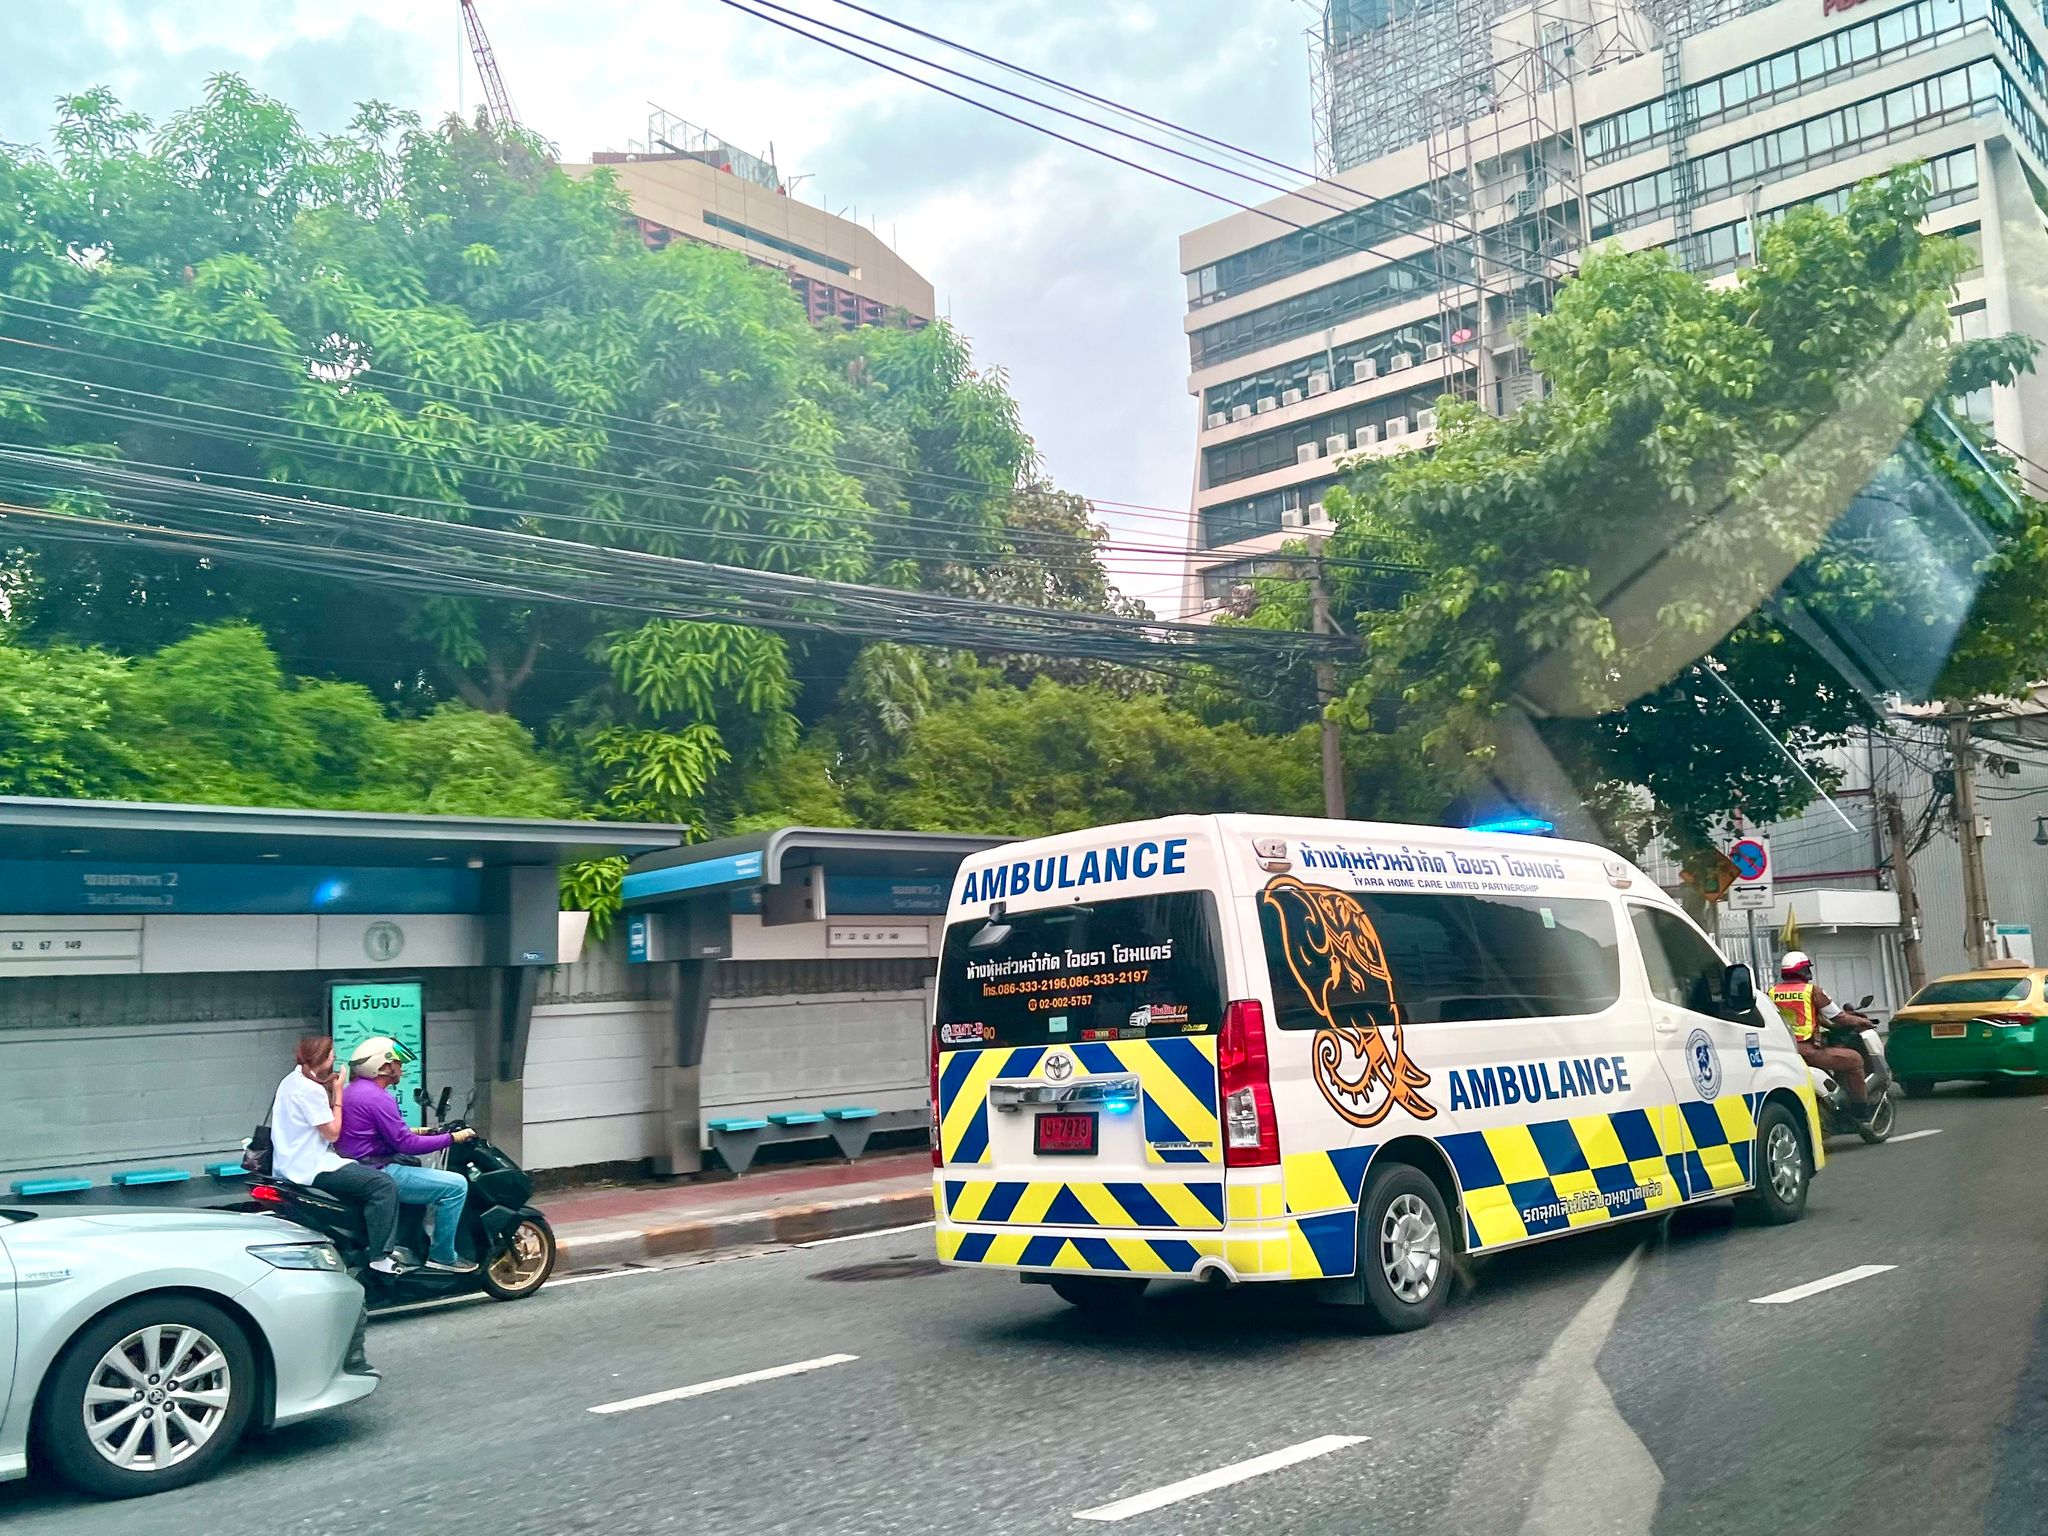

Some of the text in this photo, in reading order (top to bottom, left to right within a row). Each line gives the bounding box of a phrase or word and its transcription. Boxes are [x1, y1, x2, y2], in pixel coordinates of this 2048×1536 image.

[960, 838, 1187, 905] AMBULANCE
[1299, 842, 1448, 877] ห้างหุ้นส่วนจำกัด
[1448, 851, 1500, 876] ไอยรา
[1388, 878, 1415, 888] HOME
[1418, 879, 1443, 889] CARE
[1445, 880, 1479, 891] LIMITED
[1482, 882, 1539, 893] PARTNERSHIP
[966, 938, 1174, 983] ห้างหุ้นส่วนจำกัด ไอยรา โฮมแคร์
[1039, 995, 1093, 1010] 02-002-5757
[1774, 992, 1804, 1001] POLICE
[1449, 1055, 1631, 1112] AMBULANCE
[1522, 1178, 1663, 1224] รถฉุกเฉินได้รับอนุญาตแล้ว
